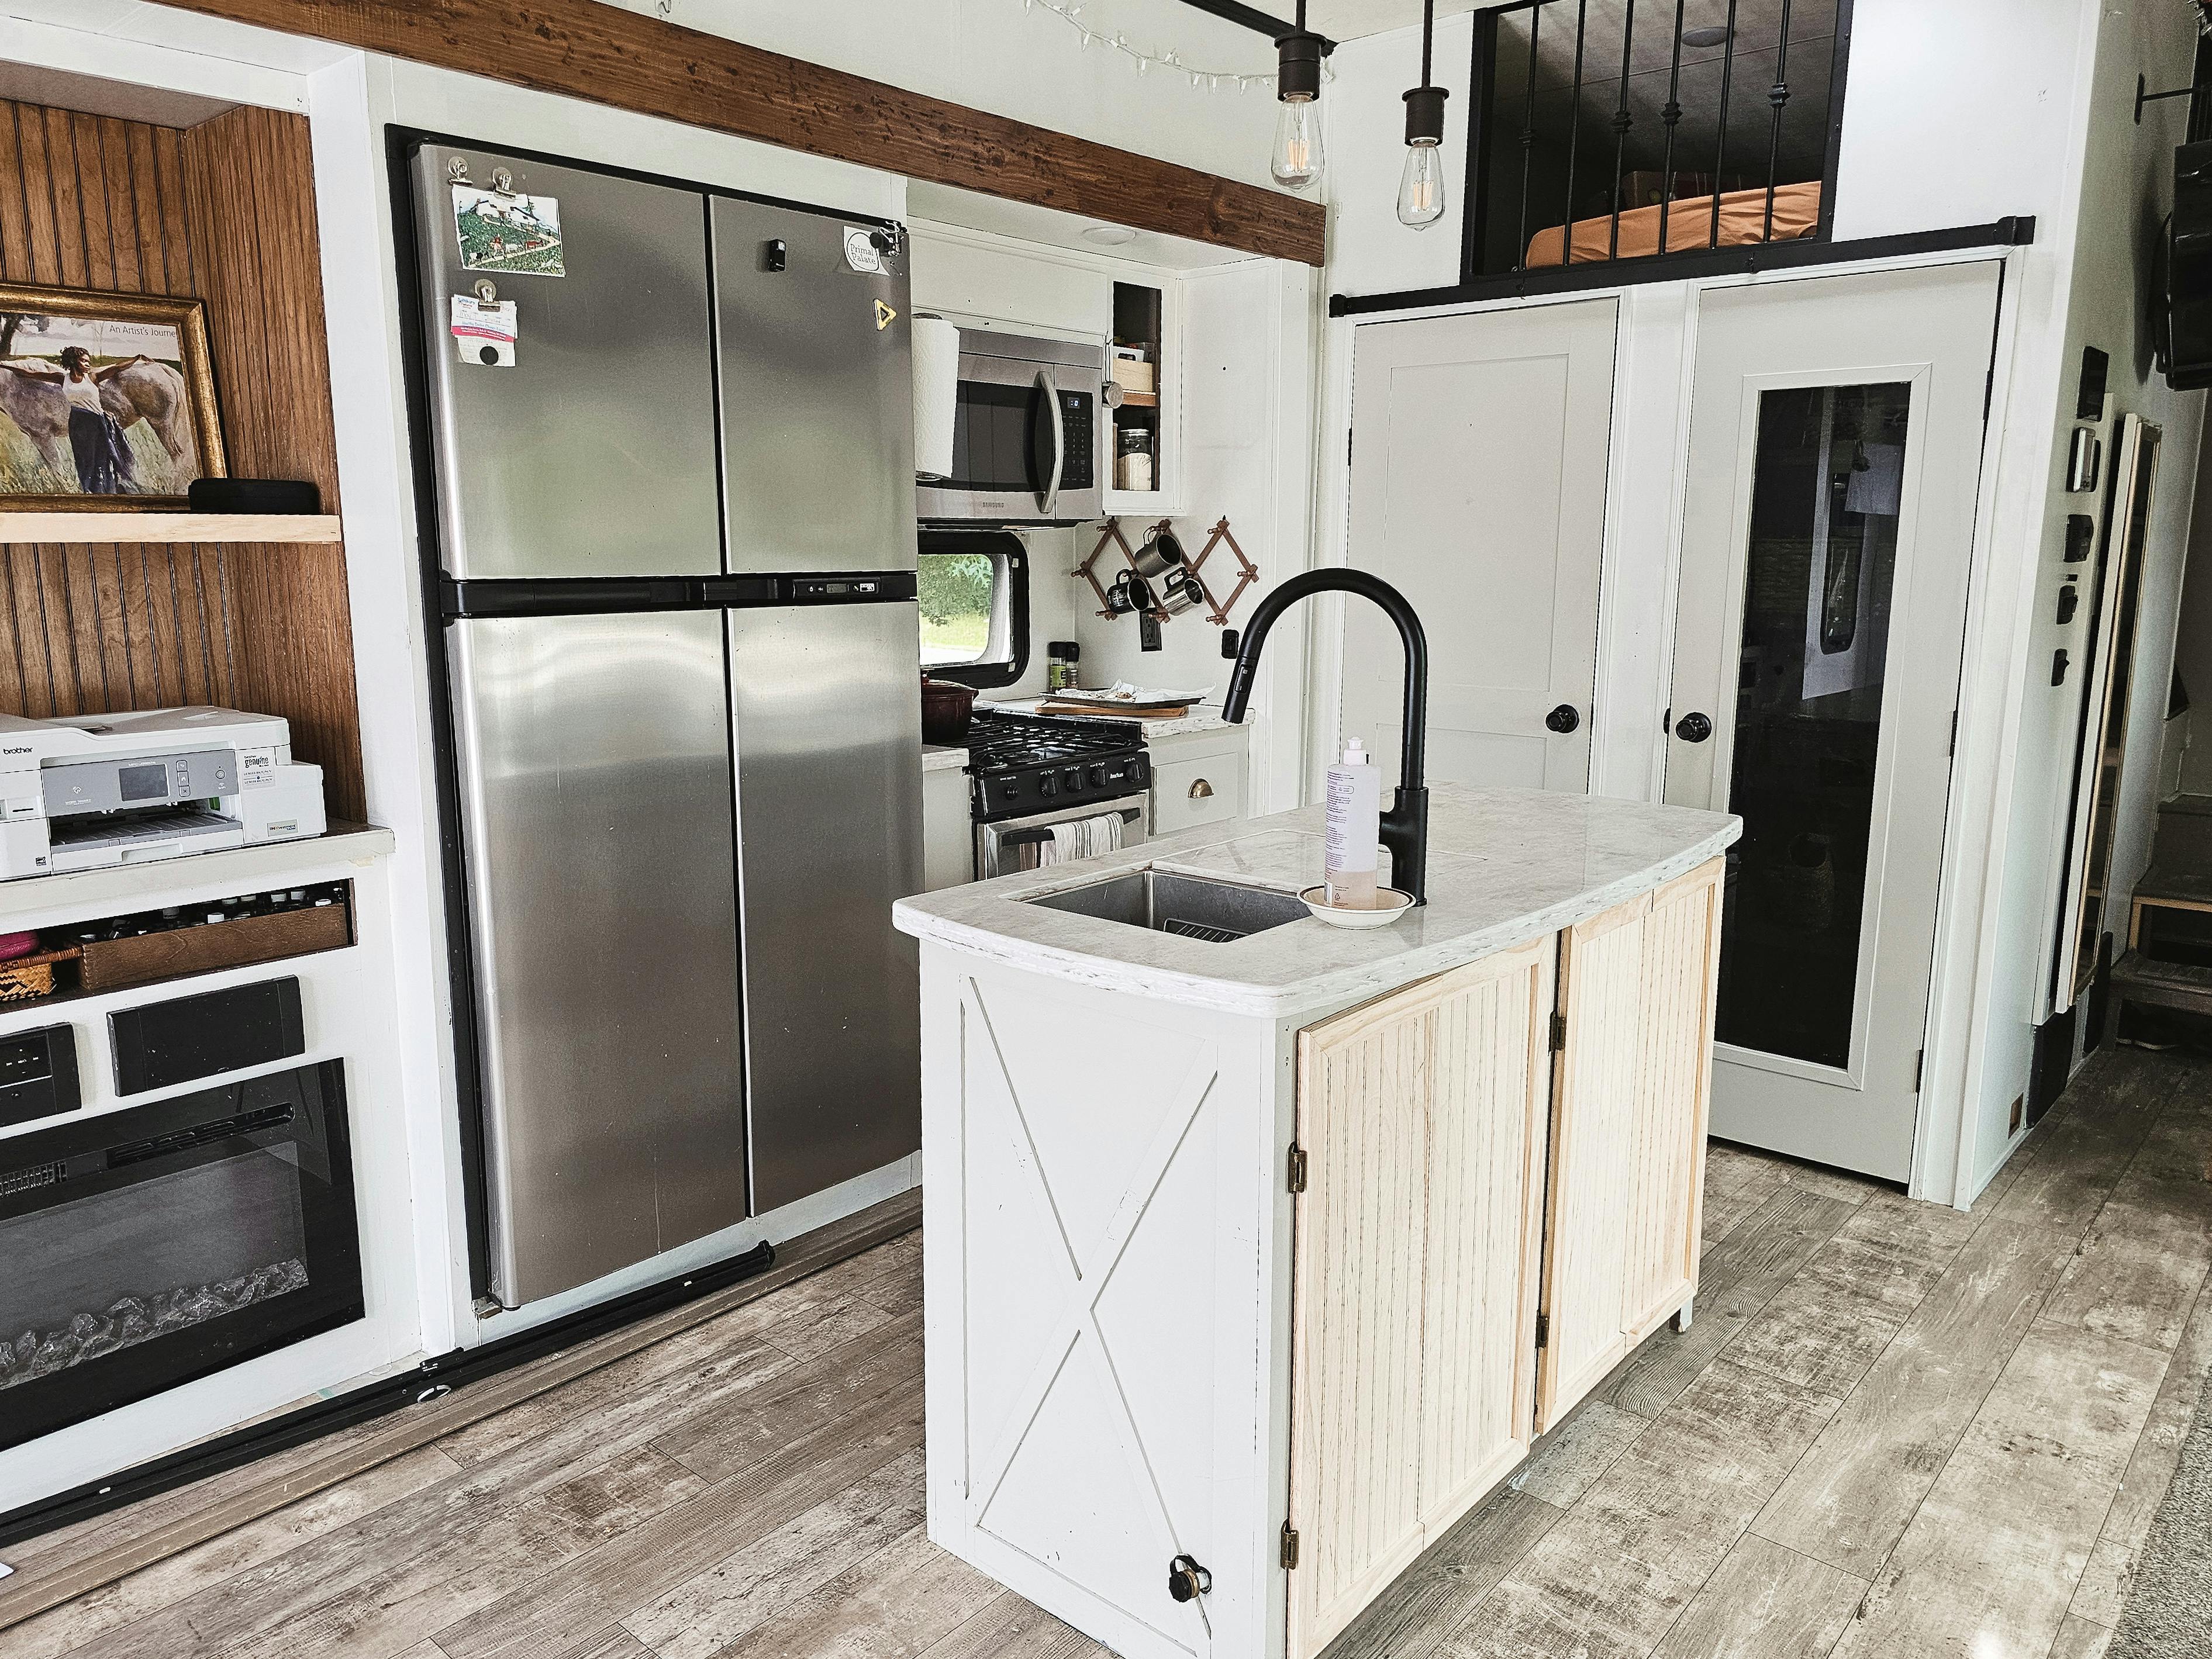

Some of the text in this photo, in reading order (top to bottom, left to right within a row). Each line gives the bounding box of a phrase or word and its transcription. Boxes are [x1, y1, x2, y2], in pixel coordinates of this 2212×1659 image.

[850, 244, 874, 255] Primal
[851, 253, 876, 264] Palate
[109, 325, 120, 334] An
[123, 326, 149, 336] Artist's
[244, 756, 269, 769] genuine
